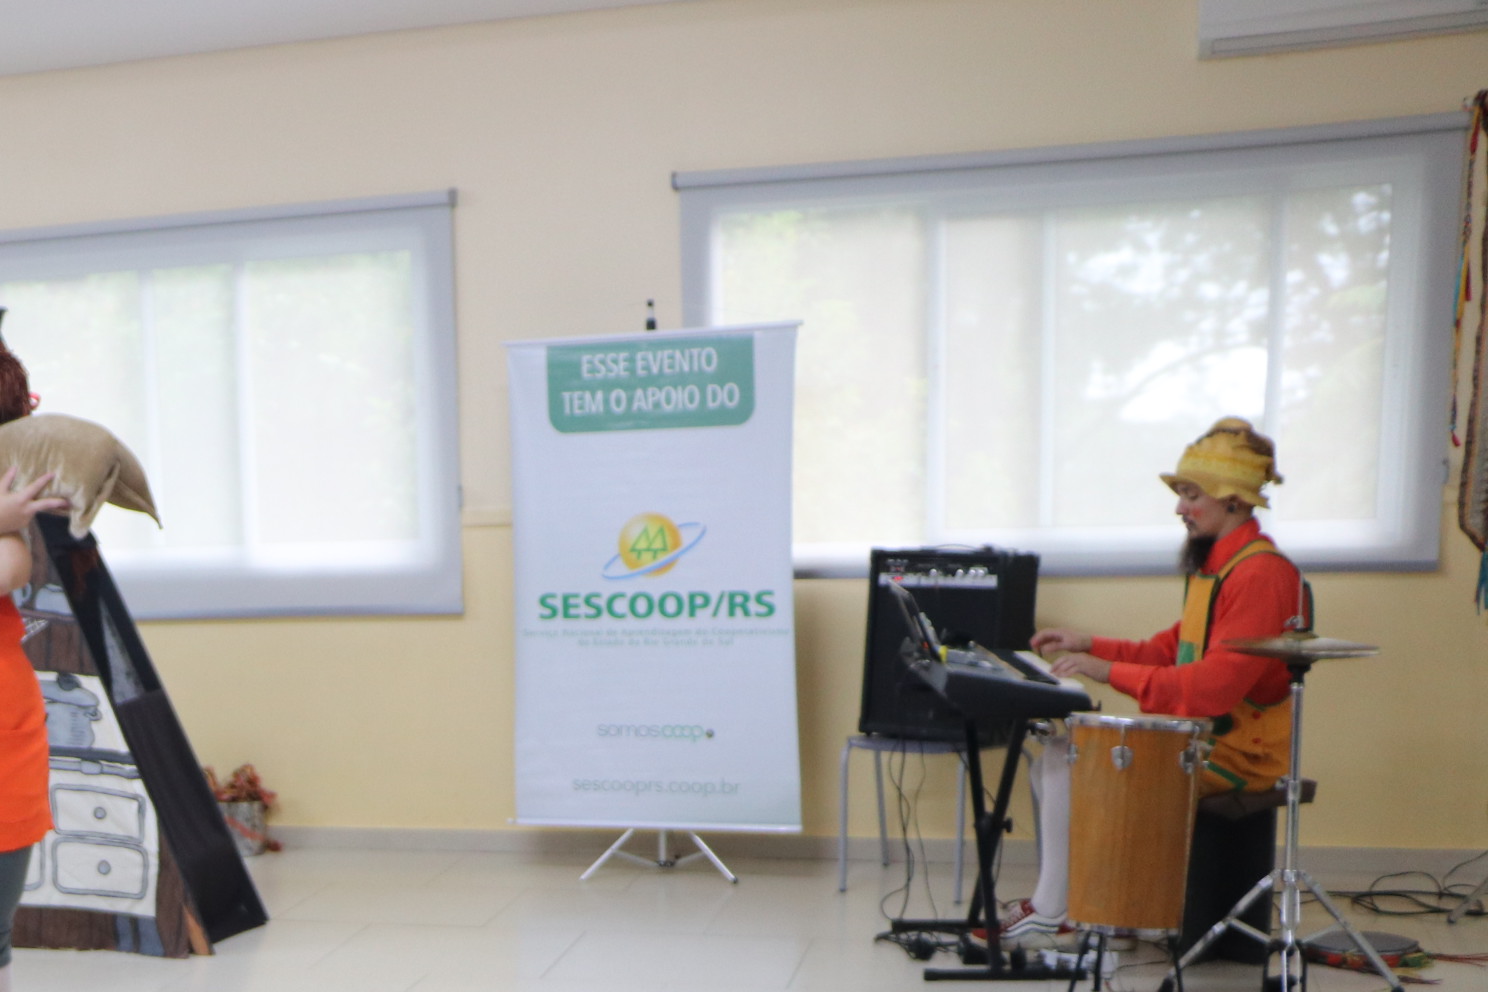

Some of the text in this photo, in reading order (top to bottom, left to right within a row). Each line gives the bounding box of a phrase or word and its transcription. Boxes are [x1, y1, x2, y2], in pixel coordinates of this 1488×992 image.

[581, 347, 718, 378] ESSE EVENTO
[561, 382, 740, 416] TEM O APOIO DO
[538, 589, 777, 620] SESCOOP/RS
